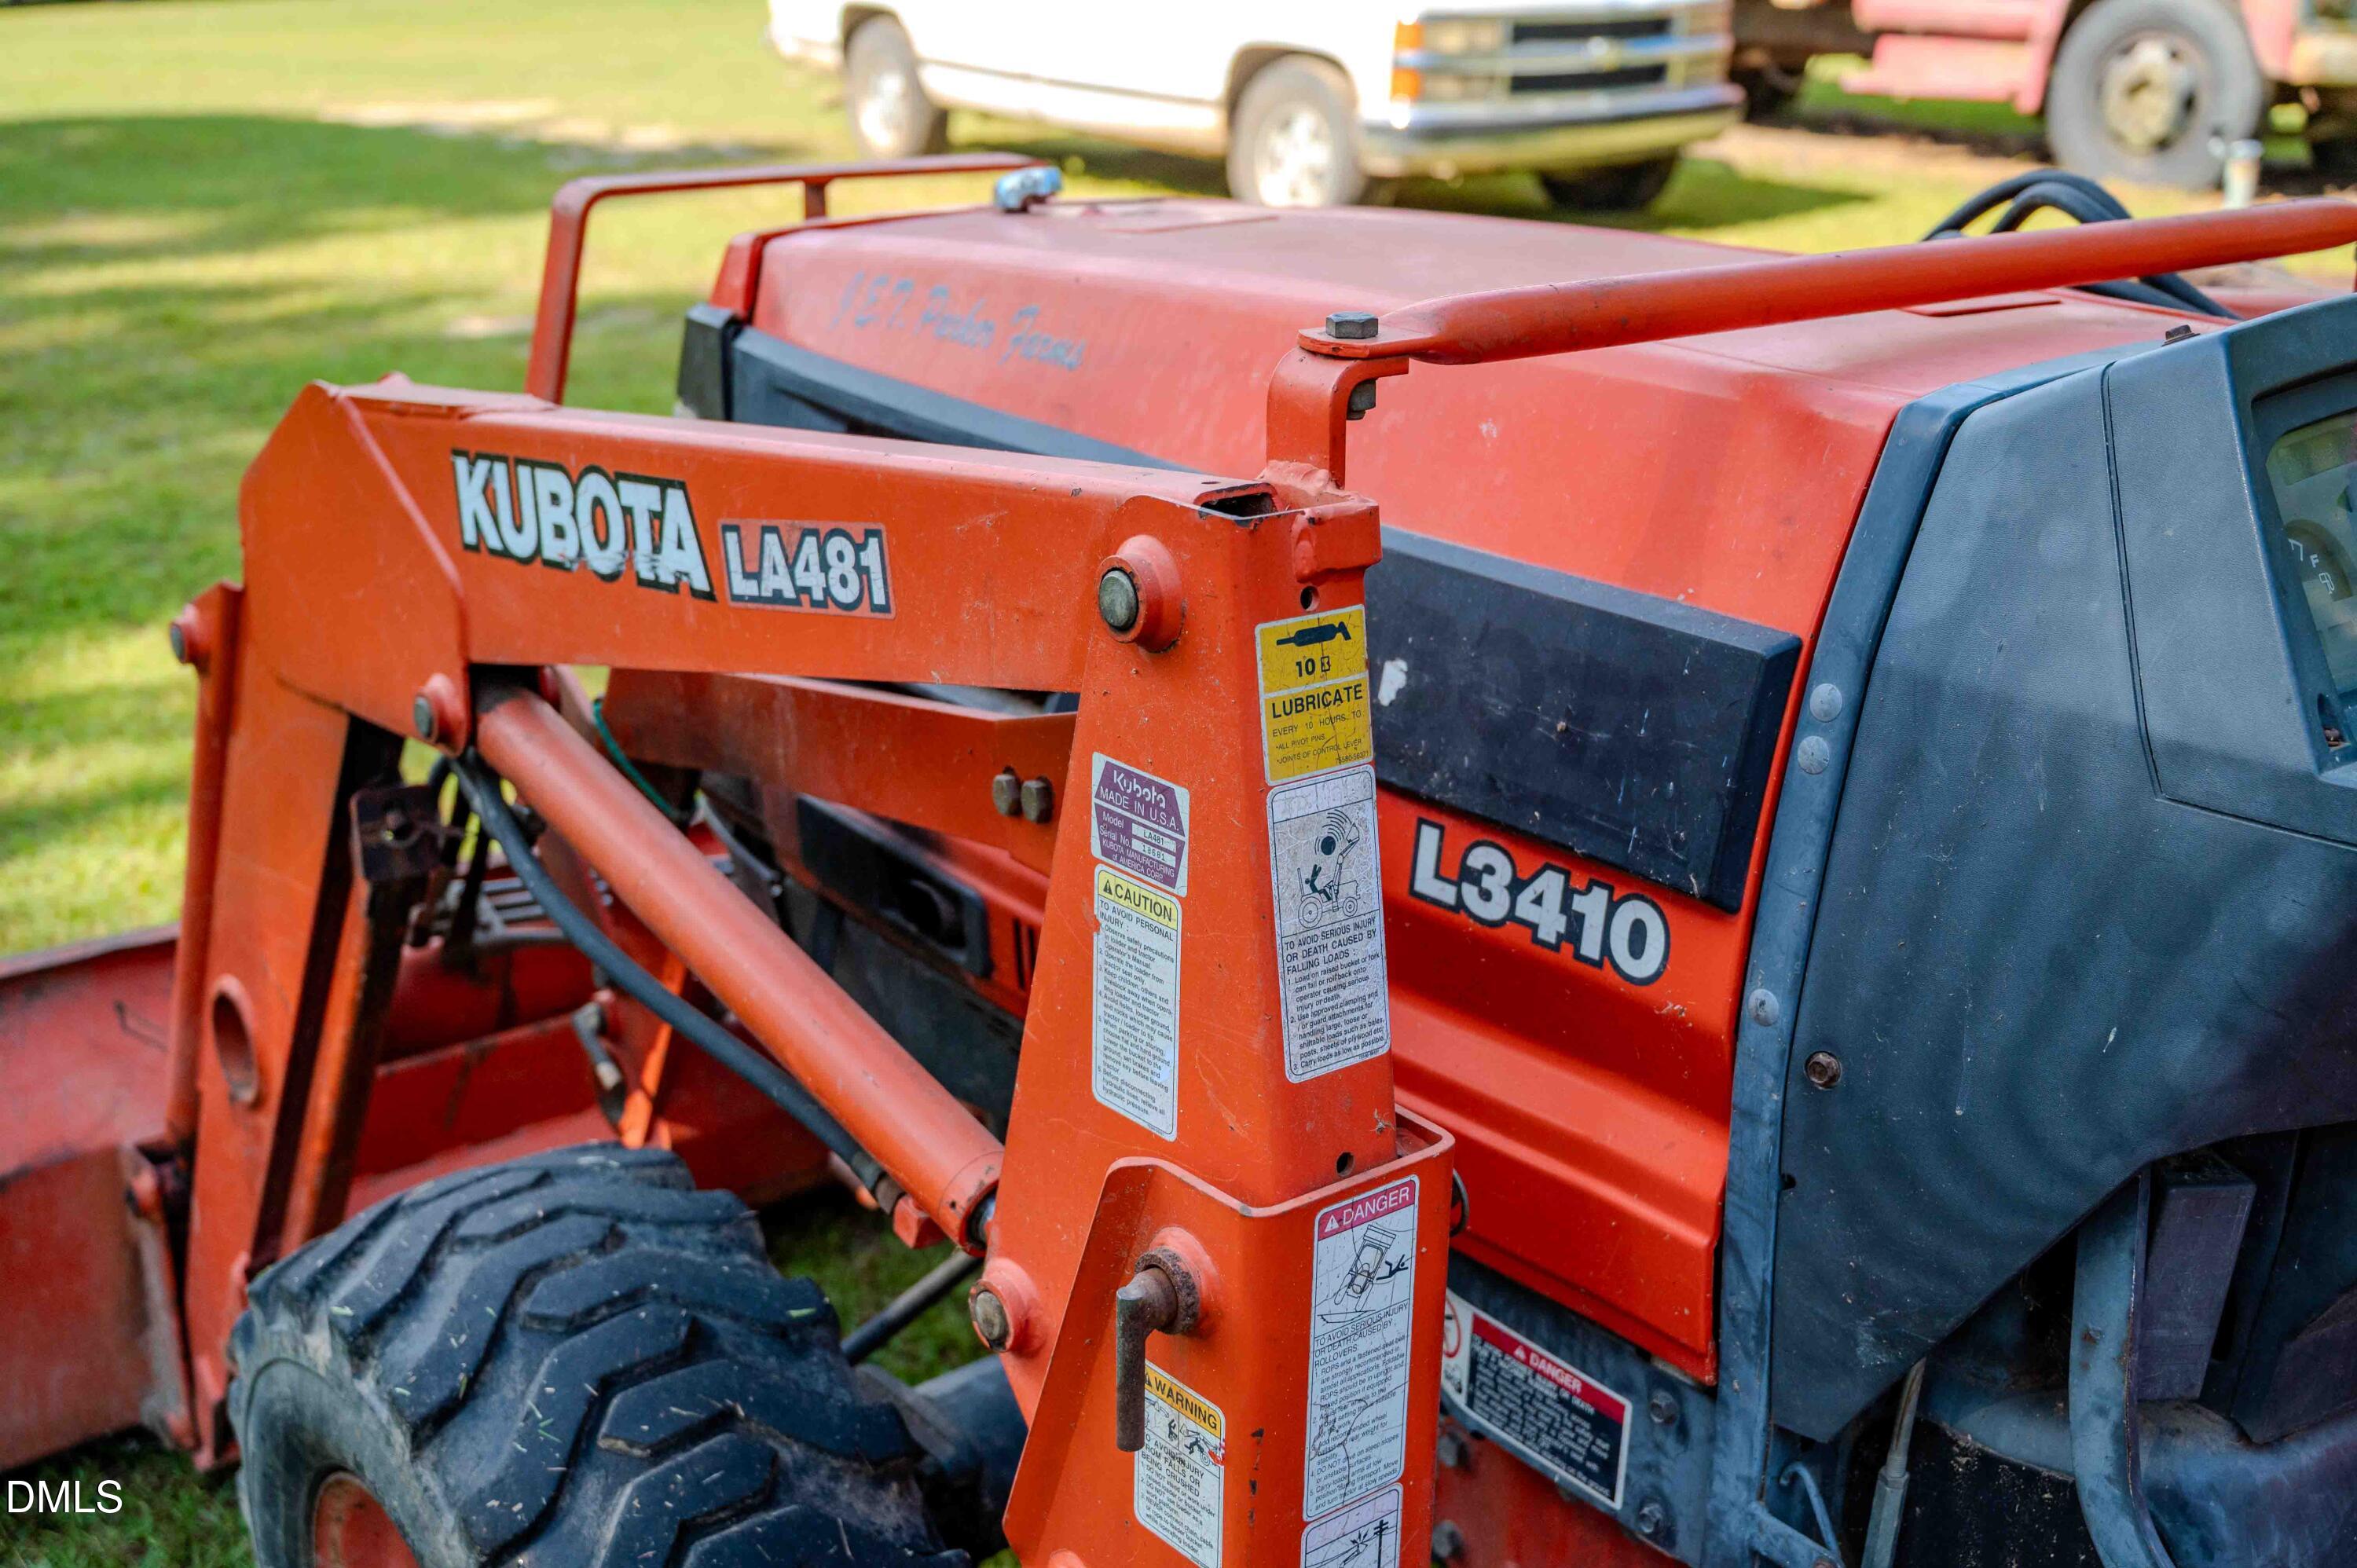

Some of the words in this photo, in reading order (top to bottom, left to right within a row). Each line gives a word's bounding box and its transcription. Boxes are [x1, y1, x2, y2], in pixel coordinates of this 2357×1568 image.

[451, 449, 717, 603] KUBOTA
[720, 524, 892, 614] LA481
[2310, 553, 2319, 568] F
[1295, 658, 1315, 678] 10
[1272, 683, 1362, 719] LUBRICATE
[1273, 724, 1298, 737] EVERY
[1305, 721, 1313, 730] 10
[1319, 713, 1345, 727] HOURS
[1352, 709, 1361, 719] TO
[1291, 737, 1308, 747] PIVOT
[1312, 742, 1340, 756] CONTROL
[1343, 738, 1361, 748] LEVER
[1113, 769, 1165, 808] Kubota
[1100, 786, 1128, 809] MADE
[1135, 800, 1144, 816] IN
[1149, 807, 1178, 831] U.S.A.
[1099, 824, 1116, 841] Serial
[1120, 833, 1131, 848] No.
[1102, 810, 1124, 829] Model
[1143, 829, 1164, 845] LA481
[1102, 837, 1123, 854] KUBOTA
[1126, 848, 1174, 877] MANUFACTURING
[1113, 852, 1117, 861] of
[1120, 855, 1144, 874] AMERICA
[1115, 881, 1171, 922] CAUTION
[1410, 817, 1670, 986] L3410
[1100, 910, 1123, 929] INJURY
[1100, 899, 1109, 910] TO
[1112, 905, 1132, 922] AVOID
[1135, 916, 1173, 942] PERSONAL
[1285, 940, 1294, 951] TO
[1298, 933, 1318, 947] AVOID
[1321, 924, 1350, 940] SERIOUS
[1353, 916, 1375, 930] INJURY
[1105, 924, 1125, 940] Observe
[1127, 935, 1142, 949] safety
[1143, 942, 1173, 963] precautions
[1110, 936, 1126, 948] loader
[1138, 949, 1155, 962] tractor
[1285, 951, 1298, 962] OR
[1302, 943, 1328, 958] DEATH
[1331, 932, 1363, 949] CAUSED
[1367, 929, 1376, 938] BY
[1104, 950, 1124, 965] Operate
[1135, 965, 1150, 978] loader
[1152, 973, 1164, 984] from
[1286, 958, 1319, 975] FALLING
[1323, 948, 1349, 964] LOADS
[1295, 973, 1310, 983] Load
[1320, 965, 1338, 976] raised
[1340, 958, 1359, 969] bucket
[1369, 951, 1379, 960] fork
[1104, 966, 1116, 979] Keep
[1141, 985, 1157, 999] others
[1159, 994, 1168, 1005] and
[1295, 984, 1306, 993] can
[1337, 969, 1351, 980] back
[1353, 966, 1365, 975] onto
[1296, 988, 1321, 1003] operator
[1322, 981, 1346, 995] causing
[1296, 1001, 1313, 1013] injury
[1297, 1012, 1309, 1020] Use
[1340, 994, 1365, 1008] clamping
[1309, 1016, 1326, 1028] guard
[1328, 1004, 1363, 1020] attachments
[1299, 1026, 1324, 1040] handling
[1343, 1015, 1359, 1024] loose
[1326, 1030, 1342, 1040] loads
[1343, 1024, 1358, 1035] such
[1347, 1029, 1372, 1043] plywood
[1300, 1057, 1316, 1068] Carry
[1318, 1052, 1332, 1062] loads
[1343, 1185, 1409, 1225] DANGER
[1314, 1346, 1325, 1357] OR
[1328, 1335, 1351, 1352] DEATH
[1353, 1323, 1381, 1342] CAUSED
[1383, 1318, 1392, 1329] BY
[1315, 1335, 1325, 1347] TO
[1327, 1326, 1349, 1343] AVOID
[1351, 1313, 1381, 1332] SERIOUS
[1384, 1302, 1407, 1318] INJURY
[1314, 1343, 1357, 1368] ROLLOVERS
[1529, 1351, 1582, 1395] DANGER
[1154, 1376, 1217, 1431] WARNING
[1142, 1450, 1161, 1471] BEING
[1165, 1467, 1199, 1497] CRUSHED
[1164, 1456, 1186, 1478] FALLS
[1189, 1475, 1200, 1487] OR
